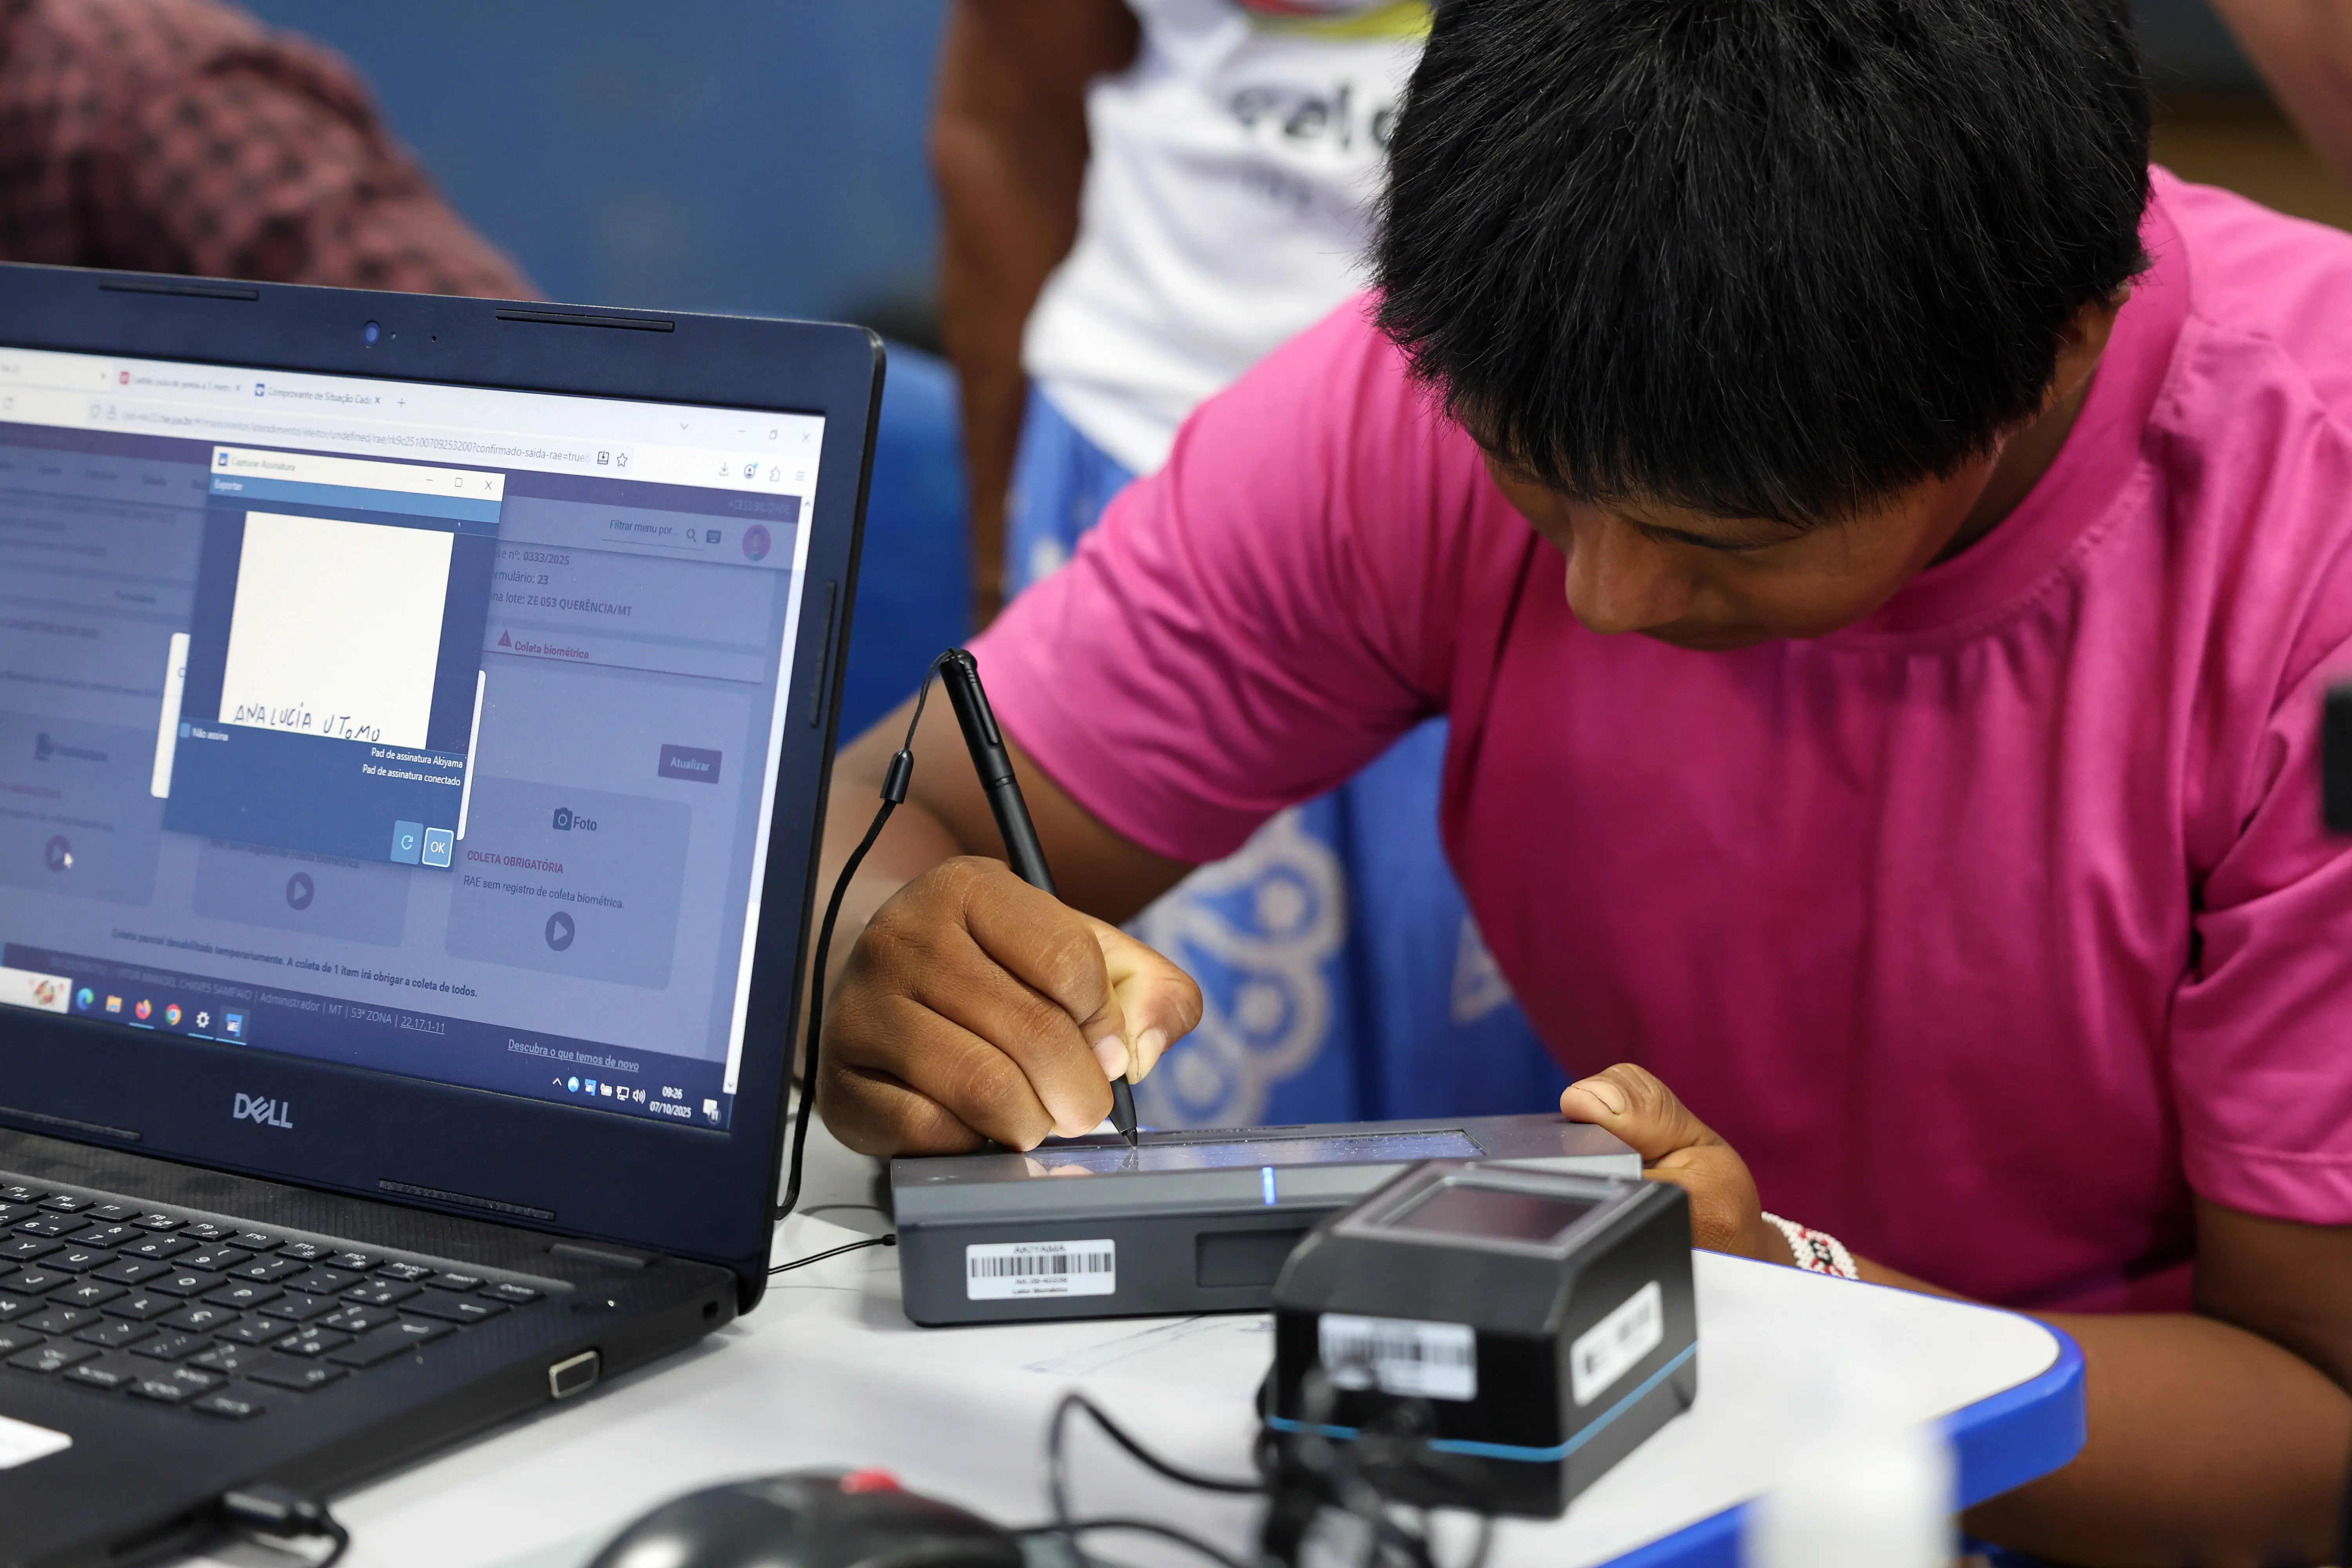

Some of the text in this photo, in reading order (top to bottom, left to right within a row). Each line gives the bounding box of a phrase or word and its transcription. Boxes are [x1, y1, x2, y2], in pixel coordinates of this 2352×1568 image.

[315, 392, 323, 400] de
[325, 392, 353, 406] Situação
[610, 520, 633, 530] Filtrar
[635, 524, 657, 533] menu
[523, 551, 570, 565] 0333/2025
[537, 574, 549, 584] 23
[506, 592, 524, 604] lote:
[527, 595, 539, 606] ZE
[541, 597, 557, 607] 053
[559, 599, 633, 616] QUERÊNCIA/MT
[515, 641, 589, 659] Coleta biométrica
[234, 703, 265, 724] ANA
[371, 747, 463, 768] Pad de assinatura Akiyama
[670, 757, 710, 771] Atualizar
[362, 764, 461, 786] Pad de assinatura conectado
[573, 816, 597, 831] Foto
[430, 841, 446, 854] OK
[467, 850, 564, 874] COLETA OBRIGATÓRIA
[464, 875, 624, 909] RAE sem registro de coleta biométrica.
[287, 957, 293, 967] A
[295, 959, 320, 971] coleta
[321, 962, 332, 973] de
[334, 964, 338, 974] 1
[341, 965, 359, 978] item
[361, 969, 372, 980] irá
[374, 971, 404, 986] obrigar
[412, 978, 437, 991] coleta
[439, 981, 450, 992] de
[452, 984, 477, 997] todos.
[259, 992, 320, 1011] Administrador
[329, 1004, 343, 1015] MT
[367, 1011, 392, 1024] ZONA
[400, 1016, 445, 1034] 22.17.1-11
[508, 1039, 548, 1055] Descubra
[558, 1050, 573, 1061] que
[576, 1051, 603, 1064] temos
[605, 1055, 616, 1066] de
[618, 1061, 639, 1071] novo
[662, 1086, 683, 1099] 09:26
[233, 1092, 293, 1129] DELL
[649, 1101, 691, 1118] 07/10/2025
